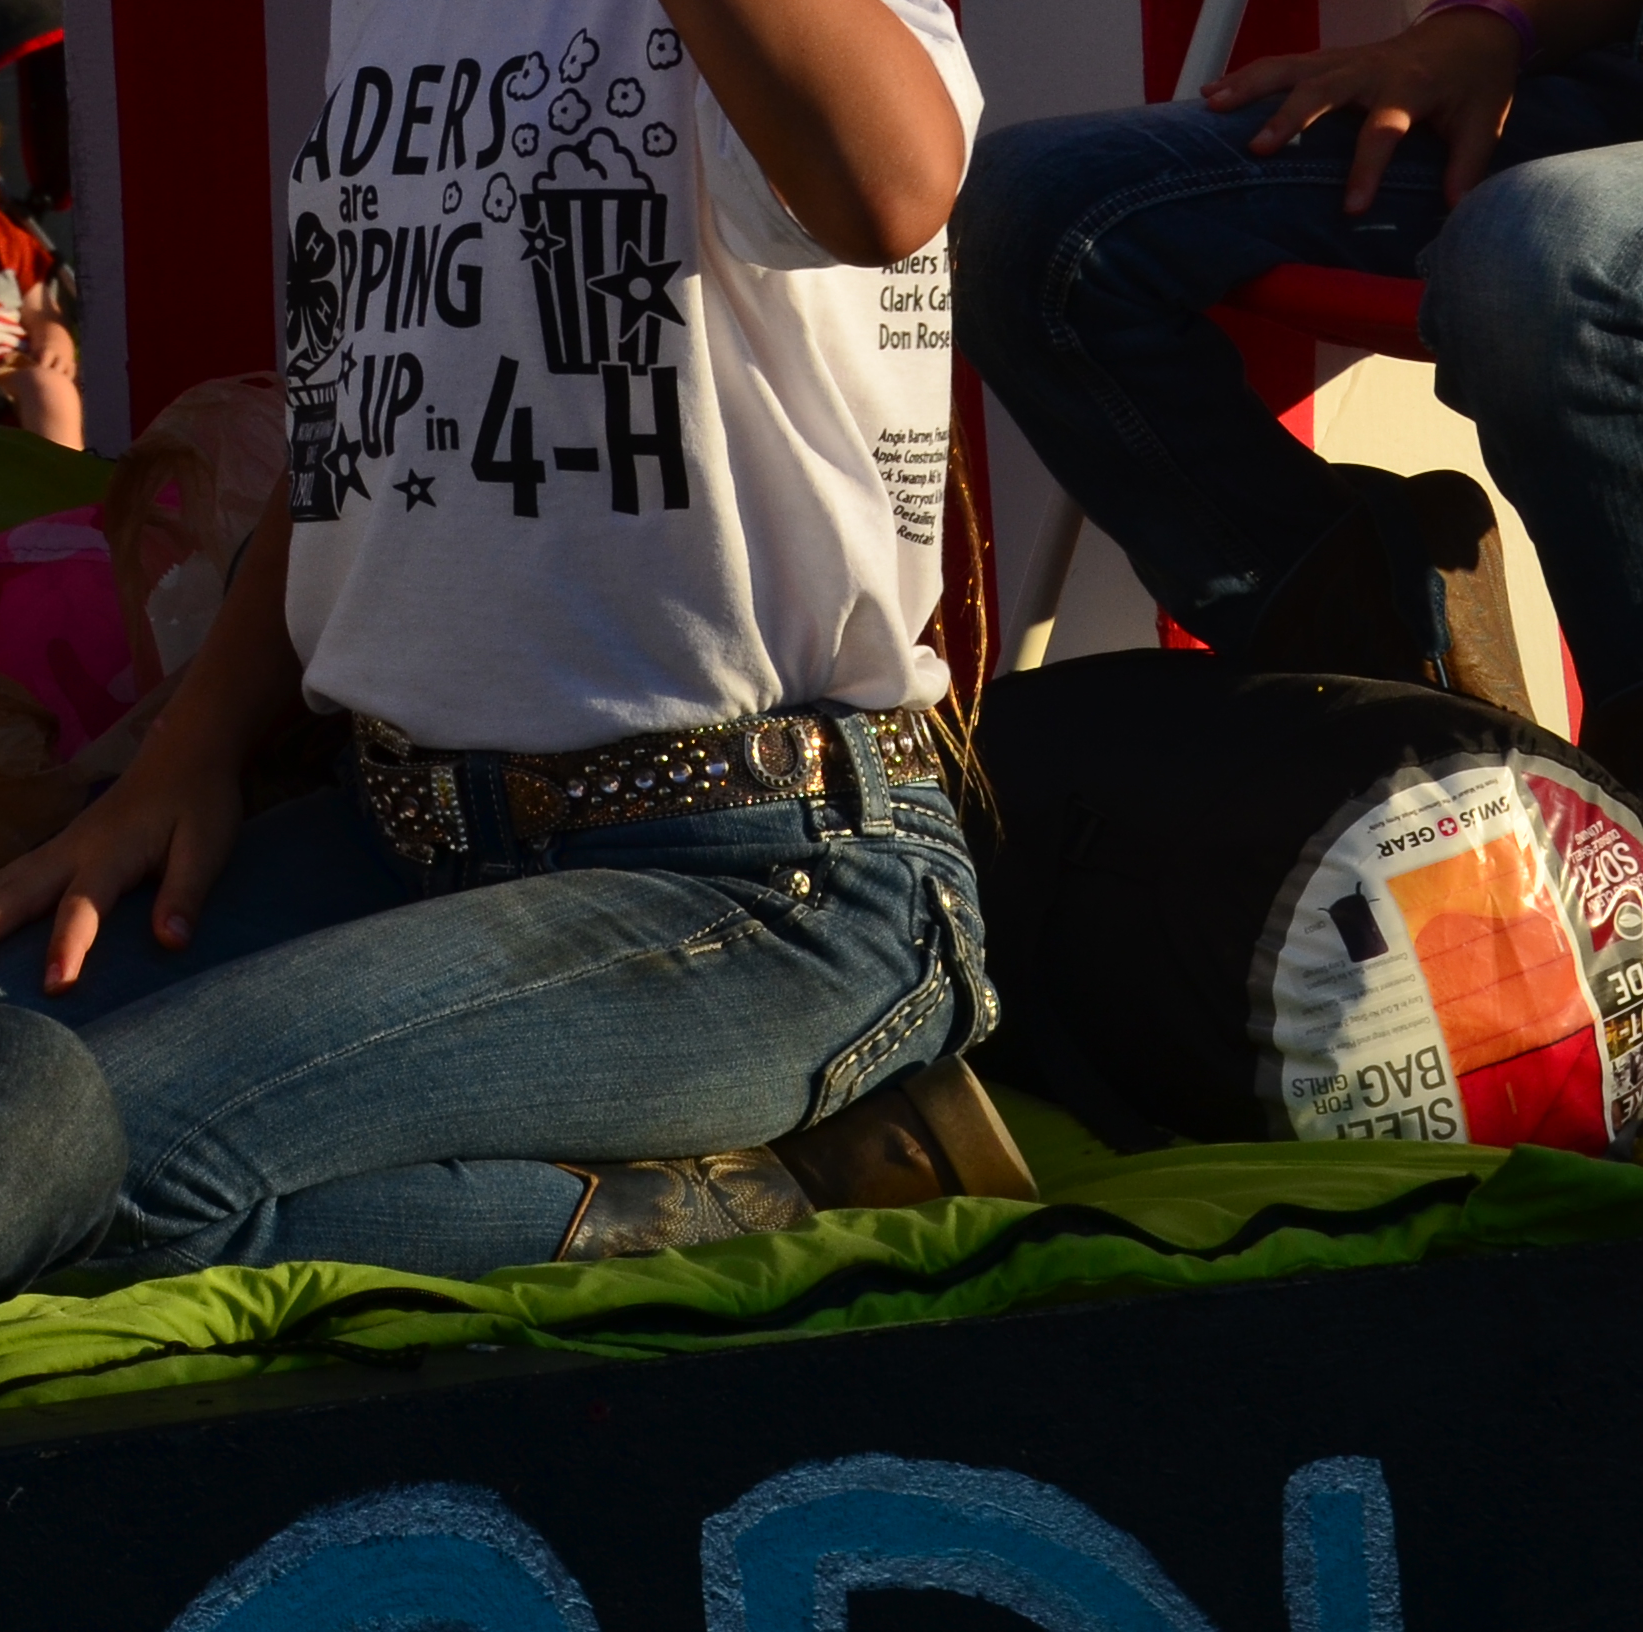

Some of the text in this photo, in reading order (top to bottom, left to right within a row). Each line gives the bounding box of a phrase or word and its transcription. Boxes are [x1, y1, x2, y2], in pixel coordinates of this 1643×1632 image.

[292, 53, 527, 183] ADERS
[339, 181, 379, 222] are
[880, 284, 923, 312] Clark
[879, 323, 911, 350] Don
[359, 351, 691, 518] UP in 4-H
[878, 428, 906, 447] Angie
[873, 447, 902, 465] Apple
[895, 469, 927, 487] Swamp
[1377, 826, 1437, 860] GEAR
[1292, 1073, 1348, 1098] GIRLS
[1357, 1045, 1447, 1109] BAG
[1314, 1092, 1354, 1116] FOR
